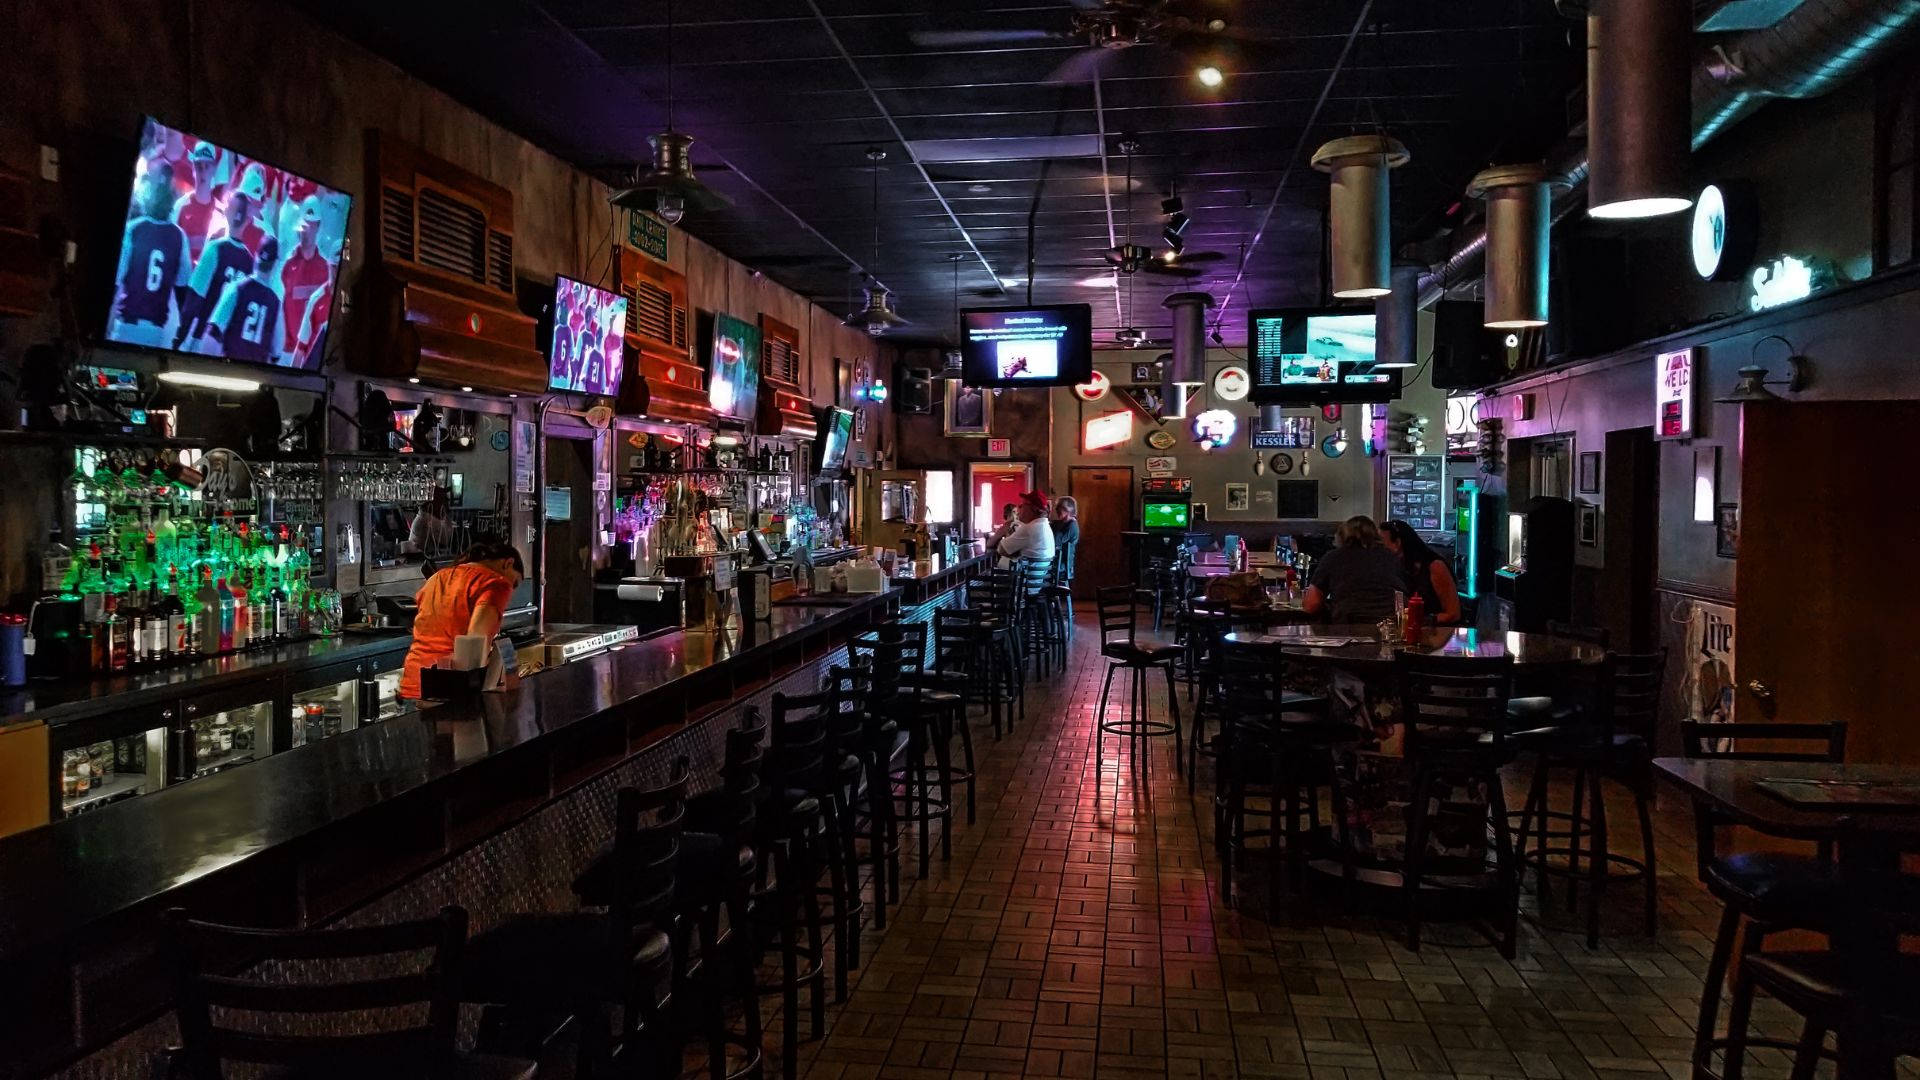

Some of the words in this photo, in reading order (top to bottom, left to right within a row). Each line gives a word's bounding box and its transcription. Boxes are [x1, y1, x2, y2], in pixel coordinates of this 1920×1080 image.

[146, 249, 165, 292] 6
[241, 301, 267, 344] 21
[992, 440, 1006, 451] EXIT
[1256, 437, 1296, 446] KESSLER
